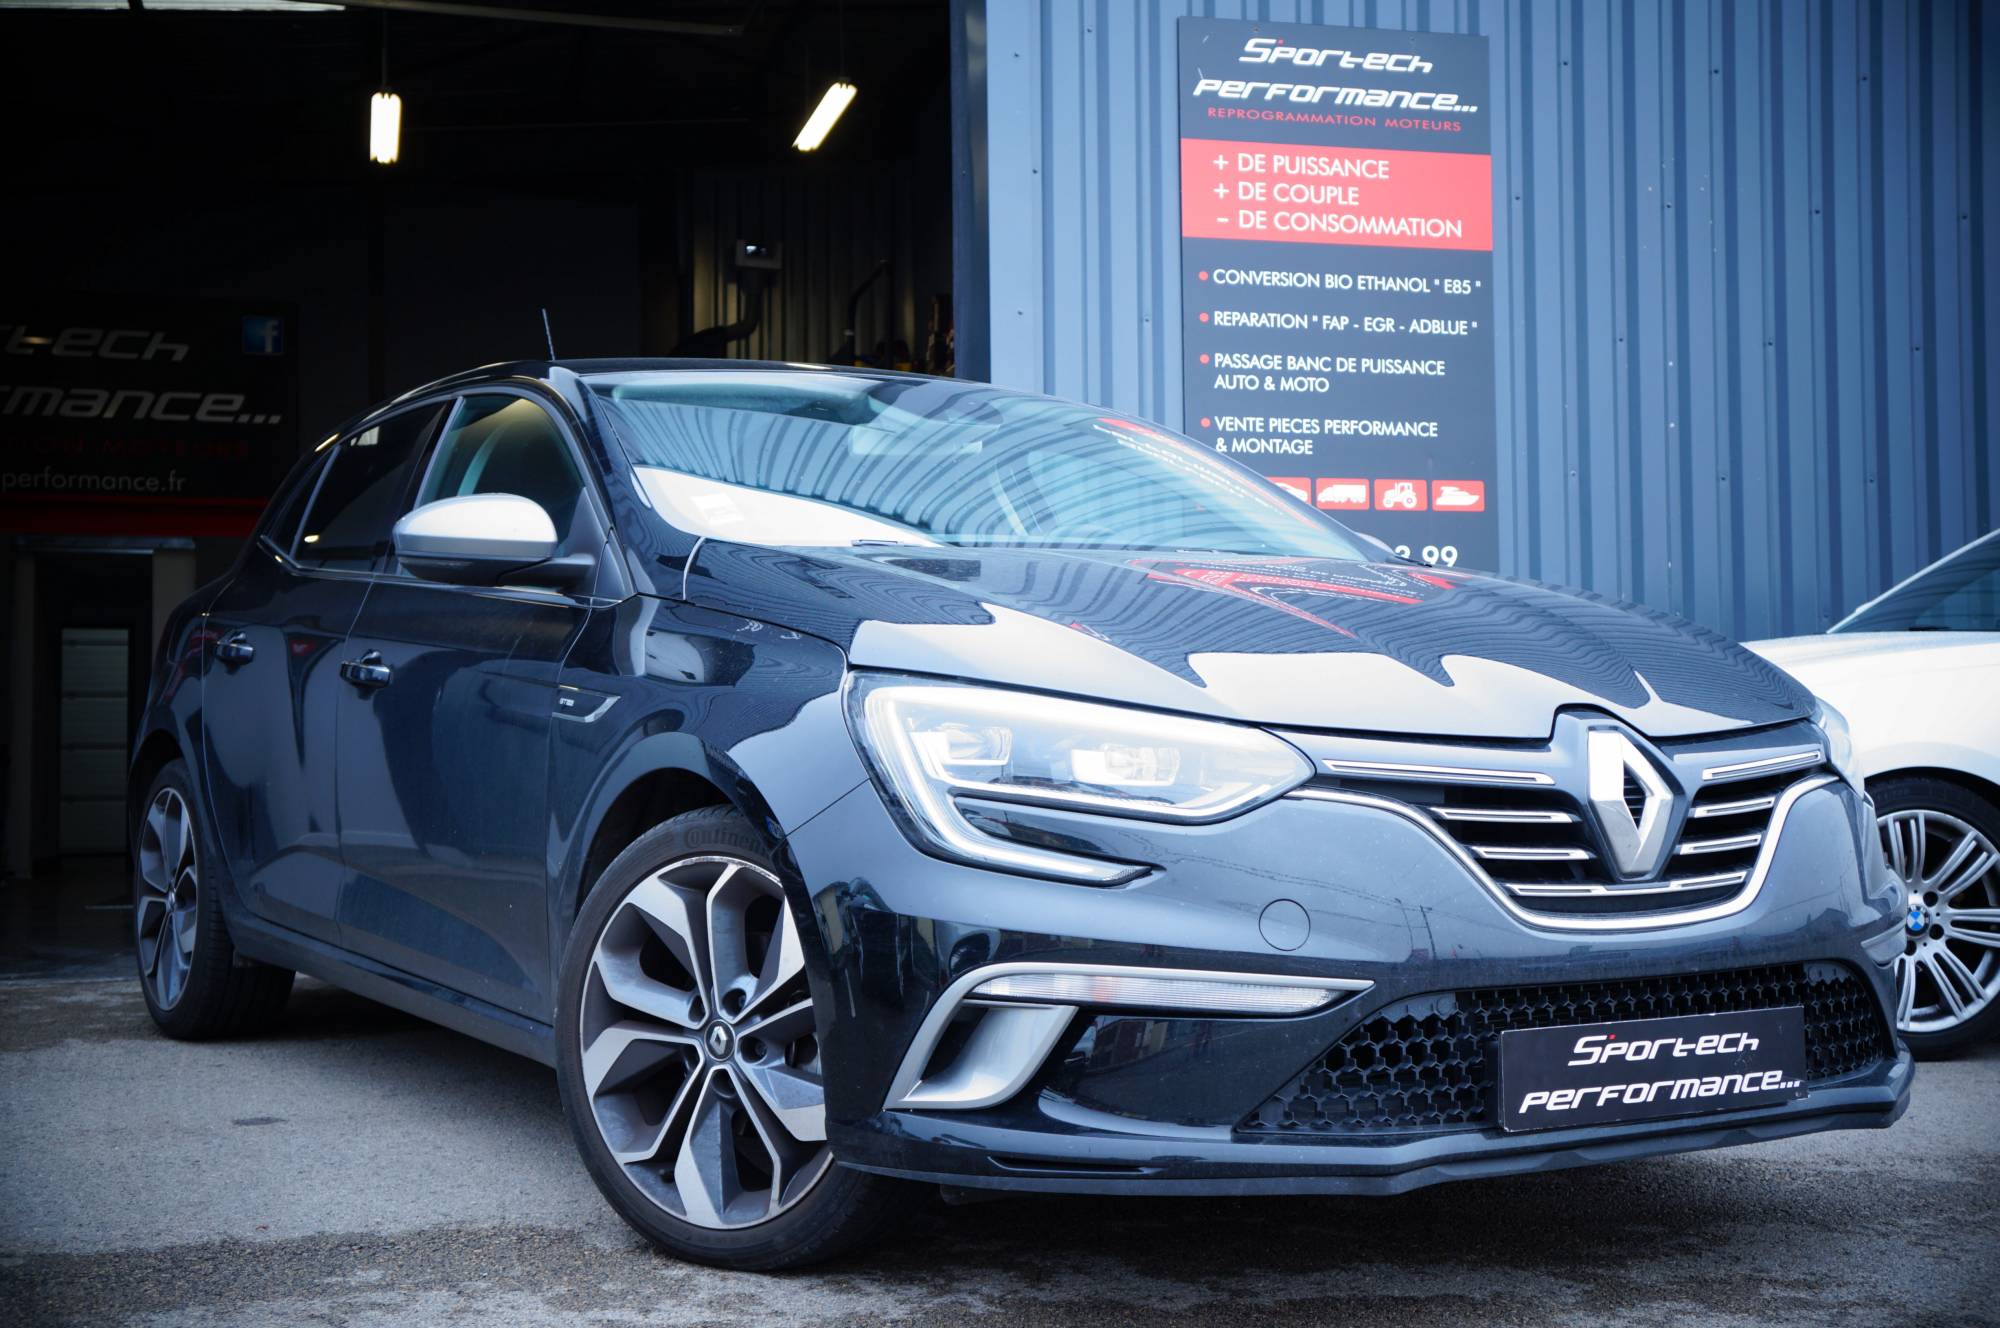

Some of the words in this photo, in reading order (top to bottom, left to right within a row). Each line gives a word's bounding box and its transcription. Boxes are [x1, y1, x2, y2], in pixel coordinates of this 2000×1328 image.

[1208, 108, 1376, 126] REPROGRAMMATION
[1385, 119, 1460, 131] MOTEURS
[1238, 153, 1265, 173] DE
[1273, 155, 1389, 179] PUISSANCE
[1238, 181, 1266, 201] DE
[1273, 183, 1359, 205] COUPLE
[1239, 210, 1267, 229] DE
[1274, 211, 1461, 237] CONSOMMATION
[1213, 269, 1319, 287] CONVERSION
[1325, 274, 1352, 289] BIO
[1358, 276, 1430, 292] ETHANOL
[1214, 311, 1307, 328] REPARATION
[1364, 317, 1395, 332] EGR
[0, 325, 190, 362] tech
[1215, 353, 1282, 370] PASSAGE
[1287, 356, 1331, 371] BANC
[1337, 358, 1356, 372] DE
[1362, 359, 1445, 375] PUISSANCE
[1214, 375, 1259, 390] AUTO
[1264, 376, 1275, 390] &
[1280, 377, 1329, 392] MOTO
[1215, 416, 1264, 432] VENTE
[1269, 418, 1320, 434] PIECES
[1325, 420, 1437, 436] PERFORMANCE
[1215, 438, 1227, 453] &
[1232, 438, 1312, 454] MONTAGE
